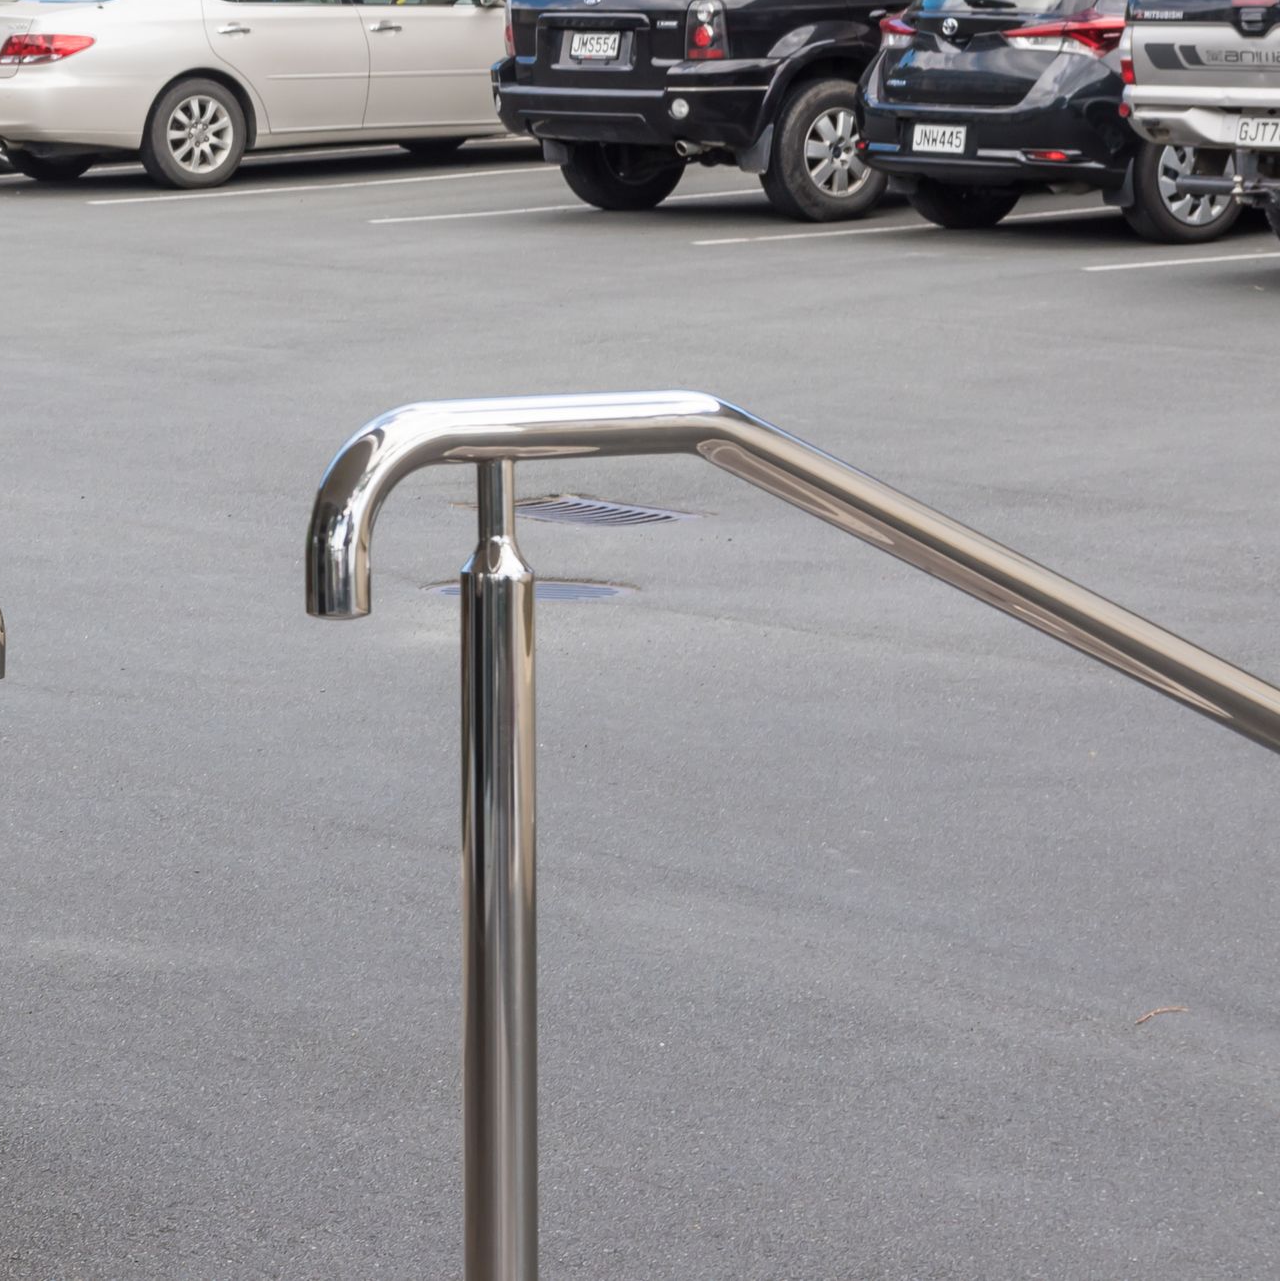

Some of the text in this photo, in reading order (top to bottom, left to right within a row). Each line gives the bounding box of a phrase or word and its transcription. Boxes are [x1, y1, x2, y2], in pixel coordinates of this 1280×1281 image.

[1143, 9, 1184, 20] MITSUBISHI
[573, 36, 617, 53] JMS554
[915, 128, 962, 148] JNW445
[1239, 122, 1280, 142] GJT7
